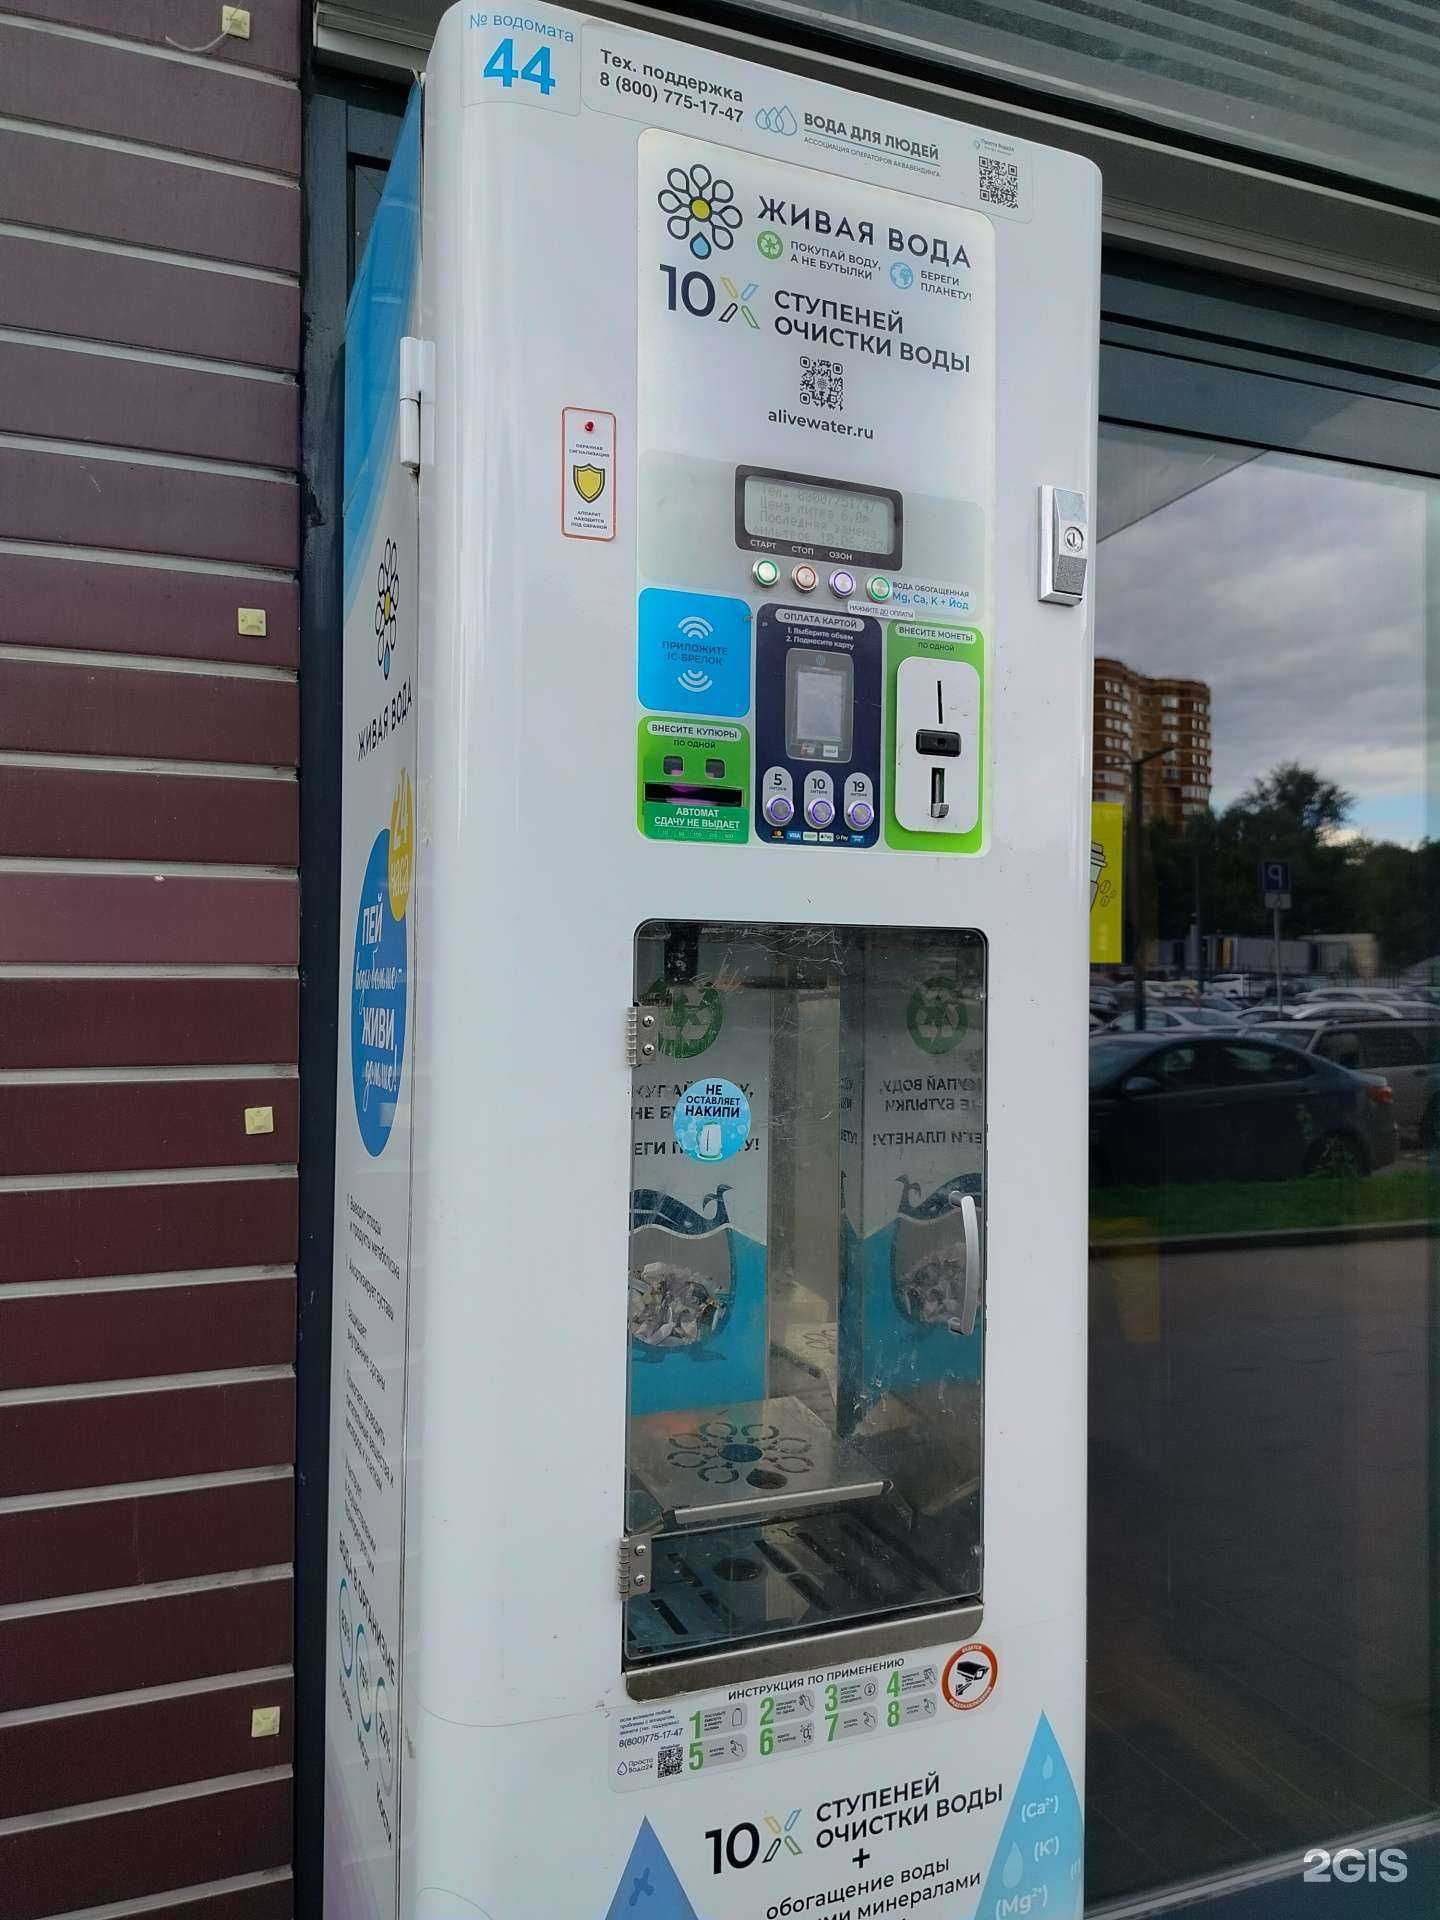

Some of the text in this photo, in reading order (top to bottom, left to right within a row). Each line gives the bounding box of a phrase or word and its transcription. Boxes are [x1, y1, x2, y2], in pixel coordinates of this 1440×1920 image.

[470, 13, 574, 42] № водомата
[482, 38, 555, 95] 44
[600, 49, 743, 102] Тех. поддержка
[600, 71, 743, 122] 8 (800) 775-17-47
[804, 112, 940, 160] ВОДА ДЛЯ ЛЮДЕЙ
[851, 149, 892, 167] ОПЕРАТОРОВ
[757, 195, 970, 268] ЖИВАЯ ВОДА
[791, 240, 881, 272] ПОКУПАЙ ВОДУ,
[791, 255, 872, 281] А НЕ БУТЫЛКИ
[921, 270, 960, 287] БЕРЕГИ
[921, 282, 973, 302] ПЛАНЕТУ!
[774, 290, 904, 335] СТУПЕНЕЙ
[774, 316, 970, 373] ОЧИСТКИ ВОДЫ
[768, 409, 874, 440] alivewater.ru
[750, 540, 853, 561] СТАРТ СТОП ОЗОН
[892, 581, 970, 598] ВОДА ОБОГАЩЕННАЯ
[892, 592, 910, 604] Mg,
[913, 594, 929, 606] Ca,
[931, 595, 938, 605] K
[949, 597, 969, 610] Йод
[784, 612, 857, 629] ОПЛАТА КАРТОЙ
[794, 627, 830, 639] Выберите
[899, 626, 973, 641] ВНЕСИТЕ МОНЕТЫ
[662, 640, 728, 656] ПРИЛОЖИТЕ
[793, 636, 833, 647] Поднесите
[834, 640, 855, 650] карту
[926, 641, 955, 652] ОДНОЙ
[358, 675, 412, 761] ЖИВАЯ ВОДА
[652, 724, 737, 738] ВНЕСИТЕ КУПЮРЫ
[673, 739, 716, 749] ПО ОДНОЙ
[773, 773, 783, 786] 5
[811, 778, 826, 790] 10
[852, 780, 865, 793] 19
[655, 816, 740, 829] СДАЧУ НЕ ВЫДАЕТ
[675, 807, 720, 818] АВТОМАТ
[362, 892, 383, 946] ПЕЙ
[361, 1007, 395, 1051] ЖИВИ
[686, 1095, 741, 1106] ОСТАВЛЯЕТ
[706, 1084, 723, 1096] НЕ
[685, 1105, 740, 1118] НАКИПИ
[728, 1678, 804, 1701] ИНСТРУКЦИЯ
[808, 1674, 823, 1685] ПО
[826, 1658, 905, 1682] ПРИМЕНЕНИЮ
[887, 1670, 899, 1698] 4
[825, 1684, 838, 1711] 3
[690, 1710, 701, 1739] 1
[760, 1697, 774, 1726] 2
[887, 1701, 900, 1728] 8
[618, 1728, 684, 1749] 8(800)775-17-47
[825, 1713, 839, 1741] 7
[760, 1728, 774, 1755] 6
[689, 1742, 704, 1770] 5
[815, 1771, 940, 1822] СТУПЕНЕЙ
[815, 1783, 1003, 1849] ОЧИСТКИ ВОДЫ
[852, 1847, 870, 1869] +
[766, 1858, 949, 1920] обогащение воды
[857, 1872, 981, 1920] минералами
